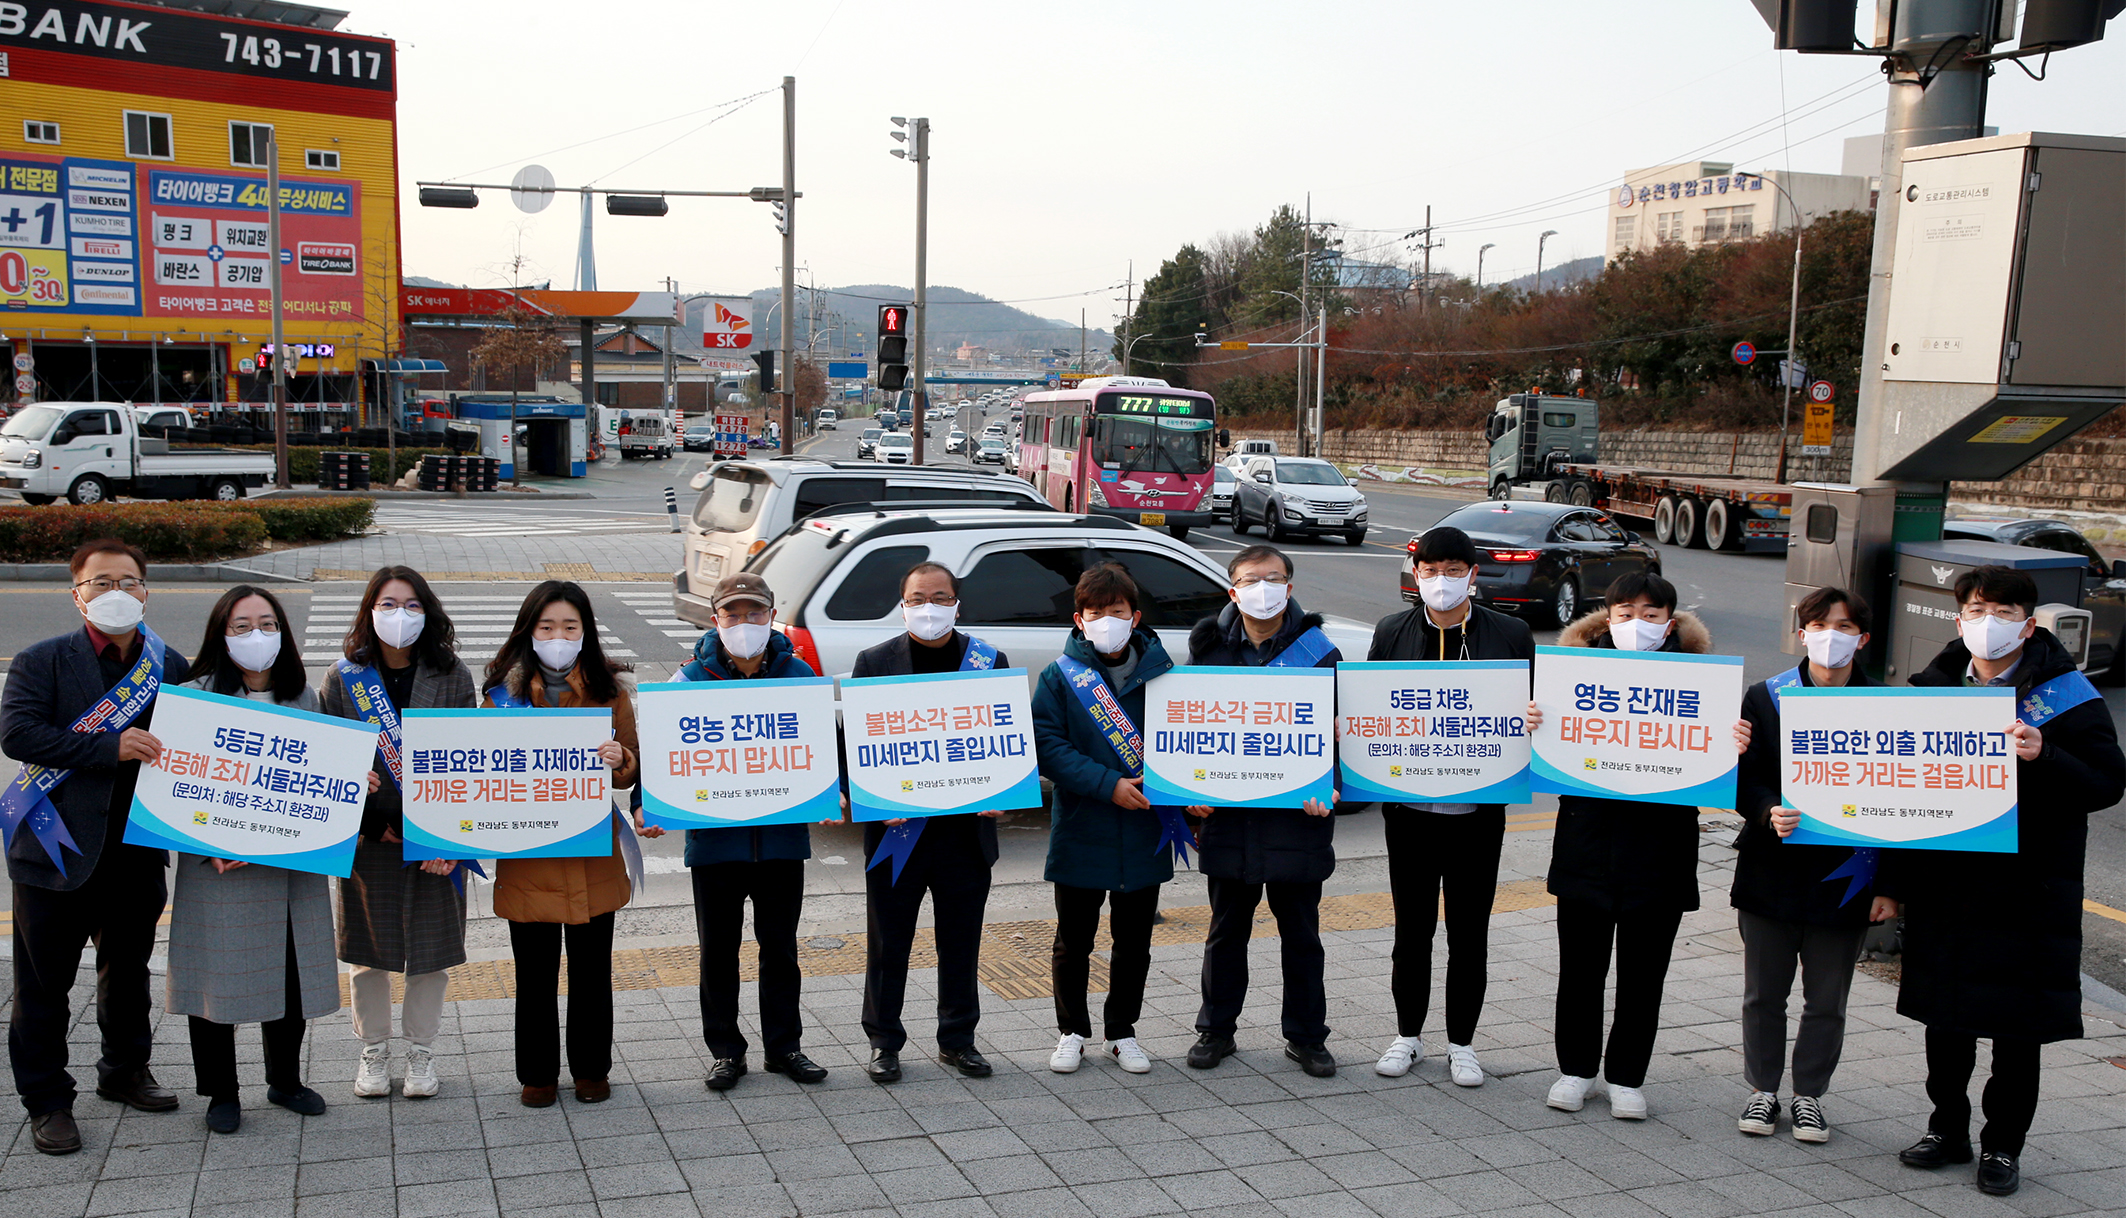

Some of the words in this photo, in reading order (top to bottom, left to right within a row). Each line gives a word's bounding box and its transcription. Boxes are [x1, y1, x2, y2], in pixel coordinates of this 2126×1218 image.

[0, 1, 152, 53] BANK
[220, 32, 381, 80] 743-7117
[10, 167, 57, 193] 전문점
[87, 175, 127, 184] MICHELIN
[89, 196, 127, 207] NEXEN
[157, 179, 234, 203] 타이어뱅크
[278, 188, 346, 210] 무상서비스
[1925, 187, 1989, 202] 도로교통관리시스템
[75, 217, 107, 226] KUMHO
[108, 219, 126, 227] TIRE
[227, 228, 268, 246] 위치교환
[84, 242, 120, 255] PIRELLI
[86, 268, 130, 276] DUNLOP
[163, 262, 200, 280] 바란스
[227, 265, 263, 283] 공기압
[81, 288, 129, 300] Continental
[407, 295, 423, 306] SK
[425, 297, 450, 306] 에너지
[159, 297, 217, 311] 타이어뱅크
[221, 298, 254, 312] 고객은
[283, 301, 326, 314] 어디서나
[716, 334, 737, 347] SK
[706, 360, 744, 369] 내트럭플러스
[1815, 387, 1829, 398] 70
[1120, 396, 1152, 412] 777
[717, 425, 747, 434] 1479
[717, 441, 746, 451] 1279
[1922, 606, 1933, 617] 표준
[1934, 608, 1960, 621] 교통신호
[351, 681, 372, 712] 생활
[1390, 688, 1432, 711] 5등급
[1436, 688, 1473, 712] 차량,
[1574, 683, 1621, 713] 영농
[1627, 686, 1701, 719] 잔재물
[1089, 703, 1113, 731] 맑고
[1092, 684, 1134, 737] 미세먼지
[1166, 700, 1249, 725] 불법소각
[1253, 701, 1314, 726] 금지로
[678, 716, 725, 743] 영농
[730, 712, 799, 741] 잔재물
[865, 707, 948, 737] 불법소각
[952, 703, 1014, 730] 금지로
[1346, 716, 1392, 738] 저공해
[1395, 716, 1426, 737] 조치
[1429, 716, 1525, 738] 서둘러주세요
[1155, 731, 1236, 755] 미세먼지
[1242, 732, 1326, 757] 줄입시다
[1560, 716, 1631, 748] 태우지
[1638, 721, 1713, 754] 맙시다
[1791, 729, 1870, 756] 불필요한
[1876, 730, 1917, 757] 외출
[1922, 730, 2007, 757] 자제하고
[213, 727, 265, 757] 5등급
[267, 735, 309, 767] 차량,
[857, 740, 940, 768] 미세먼지
[945, 733, 1028, 763] 줄입시다
[1368, 743, 1402, 758] (문의처
[1409, 743, 1431, 758] 해당
[1432, 743, 1464, 758] 주소지
[1466, 743, 1502, 758] 환경과)
[412, 748, 487, 773] 불필요한
[491, 748, 527, 773] 외출
[532, 748, 604, 772] 자제하고
[669, 748, 738, 777] 태우지
[744, 744, 814, 775] 맙시다
[1600, 760, 1632, 772] 전라남도
[1634, 762, 1683, 776] 동부지역본부
[151, 747, 210, 779] 저공해
[211, 757, 251, 786] 조치
[251, 765, 361, 805] 서둘러주세요
[1209, 771, 1238, 780] 전라남도
[1240, 771, 1284, 781] 동부지역본부
[1405, 767, 1434, 776] 전라남도
[1437, 767, 1481, 776] 동부지역본부
[1791, 761, 1850, 787] 가까운
[1856, 762, 1917, 789] 거리는
[1922, 763, 2009, 791] 걸읍시다
[412, 779, 468, 803] 가까운
[473, 779, 527, 803] 거리는
[532, 777, 606, 802] 걸읍시다
[916, 779, 946, 790] 전라남도
[948, 775, 992, 787] 동부지역본부
[172, 781, 216, 803] (문의처
[222, 790, 249, 809] 해당
[250, 795, 287, 815] 주소지
[289, 801, 330, 823] 환경과)
[711, 789, 742, 800] 전라남도
[744, 787, 790, 797] 동부지역본부
[1860, 806, 1896, 817] 전라남도
[1899, 807, 1954, 818] 동부지역본부
[212, 816, 247, 830] 전라남도
[250, 822, 302, 839] 동부지역본부
[477, 821, 509, 830] 전라남도
[511, 820, 559, 830] 동부지역본부
